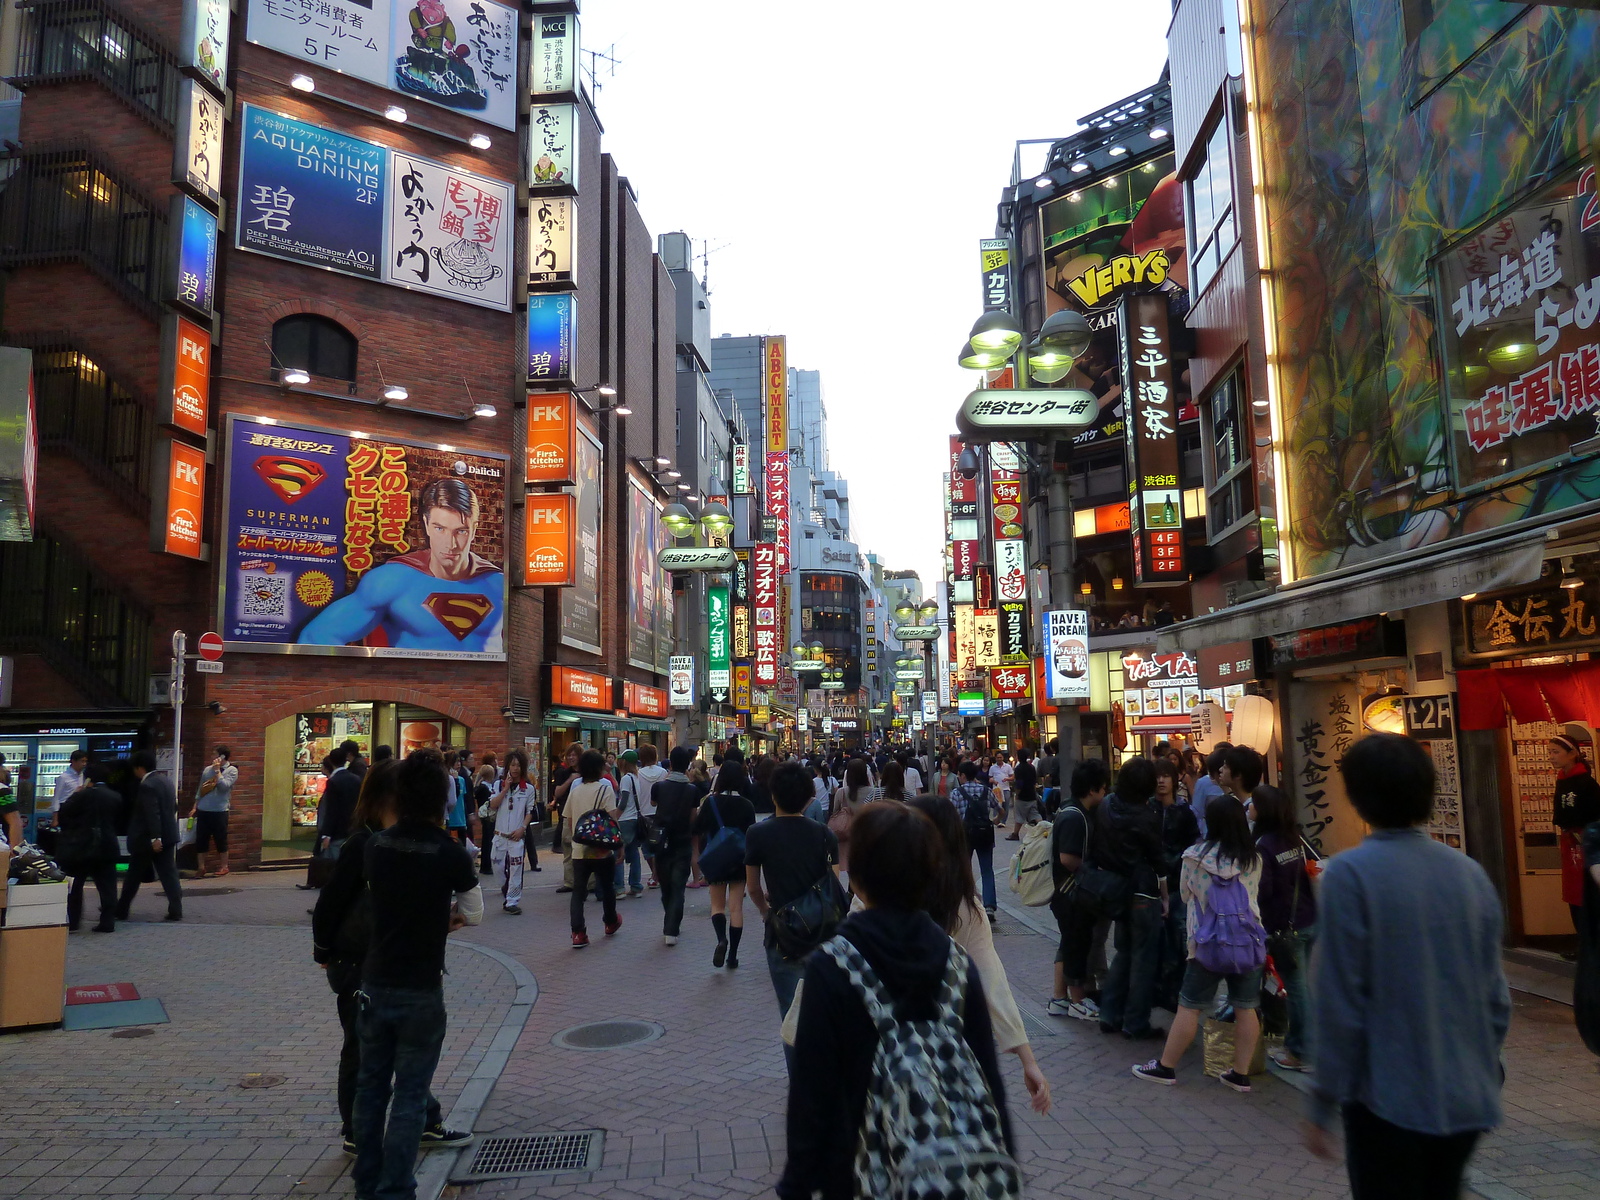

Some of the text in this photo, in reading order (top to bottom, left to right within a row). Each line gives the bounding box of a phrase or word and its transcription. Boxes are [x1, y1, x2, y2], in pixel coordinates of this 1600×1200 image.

[263, 0, 379, 52] モニタールーム
[542, 22, 566, 32] MCC
[304, 37, 340, 60] 5F
[555, 39, 563, 80] 渋谷消費者
[543, 43, 552, 84] モニタールーム
[254, 115, 379, 160] 渋谷初!アクアリウムダイニング!
[253, 129, 379, 175] AQUARIUM
[297, 155, 379, 189] DINING
[356, 188, 378, 205] 2F
[187, 204, 198, 219] 2F
[247, 185, 295, 232] 碧
[443, 180, 472, 238] もつ鍋
[472, 189, 499, 244] 博多
[396, 162, 434, 283] よかろう門
[246, 229, 268, 237] DEEP
[271, 234, 292, 244] BLUE
[246, 236, 266, 245] PURE
[988, 258, 1003, 268] 3F
[181, 271, 199, 302] 碧
[1067, 249, 1169, 307] VERY'S
[1452, 231, 1562, 338] 北海道
[531, 299, 546, 309] 2F
[182, 337, 205, 365] FK
[530, 351, 552, 376] 碧
[176, 397, 203, 415] Kitchen
[182, 392, 199, 406] First
[971, 399, 1091, 416] 渋谷センター街
[533, 405, 562, 421] FK
[175, 460, 199, 485] FK
[468, 465, 500, 478] Daiichi
[735, 446, 745, 492] 麻雀メトロ
[996, 484, 1018, 498] すき家
[1144, 475, 1176, 486] 渋谷店
[377, 446, 412, 553] この速さ、
[176, 516, 193, 529] First
[247, 509, 330, 525] SUPERMAN
[261, 520, 316, 530] RETURNS
[533, 508, 562, 524] FK
[170, 522, 198, 537] Kitchen
[1157, 534, 1173, 543] 4F
[661, 553, 730, 563] 渋谷センター街
[823, 547, 852, 564] Saint
[1157, 548, 1174, 556] 3F
[756, 547, 774, 604] カラオケ
[1158, 561, 1175, 570] 2F
[710, 595, 725, 658] ふらんす亭
[1051, 613, 1086, 625] HAVE A
[1485, 588, 1595, 646] 金伝丸
[1007, 612, 1022, 655] カラオケ
[1052, 625, 1087, 637] DREAM!
[756, 630, 775, 680] 歌広場
[1055, 655, 1088, 672] 高松
[995, 668, 1027, 690] すき家
[1123, 656, 1161, 682] THE
[570, 680, 599, 696] First Kitchen
[736, 683, 749, 706] 松屋
[1201, 708, 1212, 734] 居酒屋
[1420, 697, 1450, 730] 2F
[1190, 713, 1204, 746] 三平
